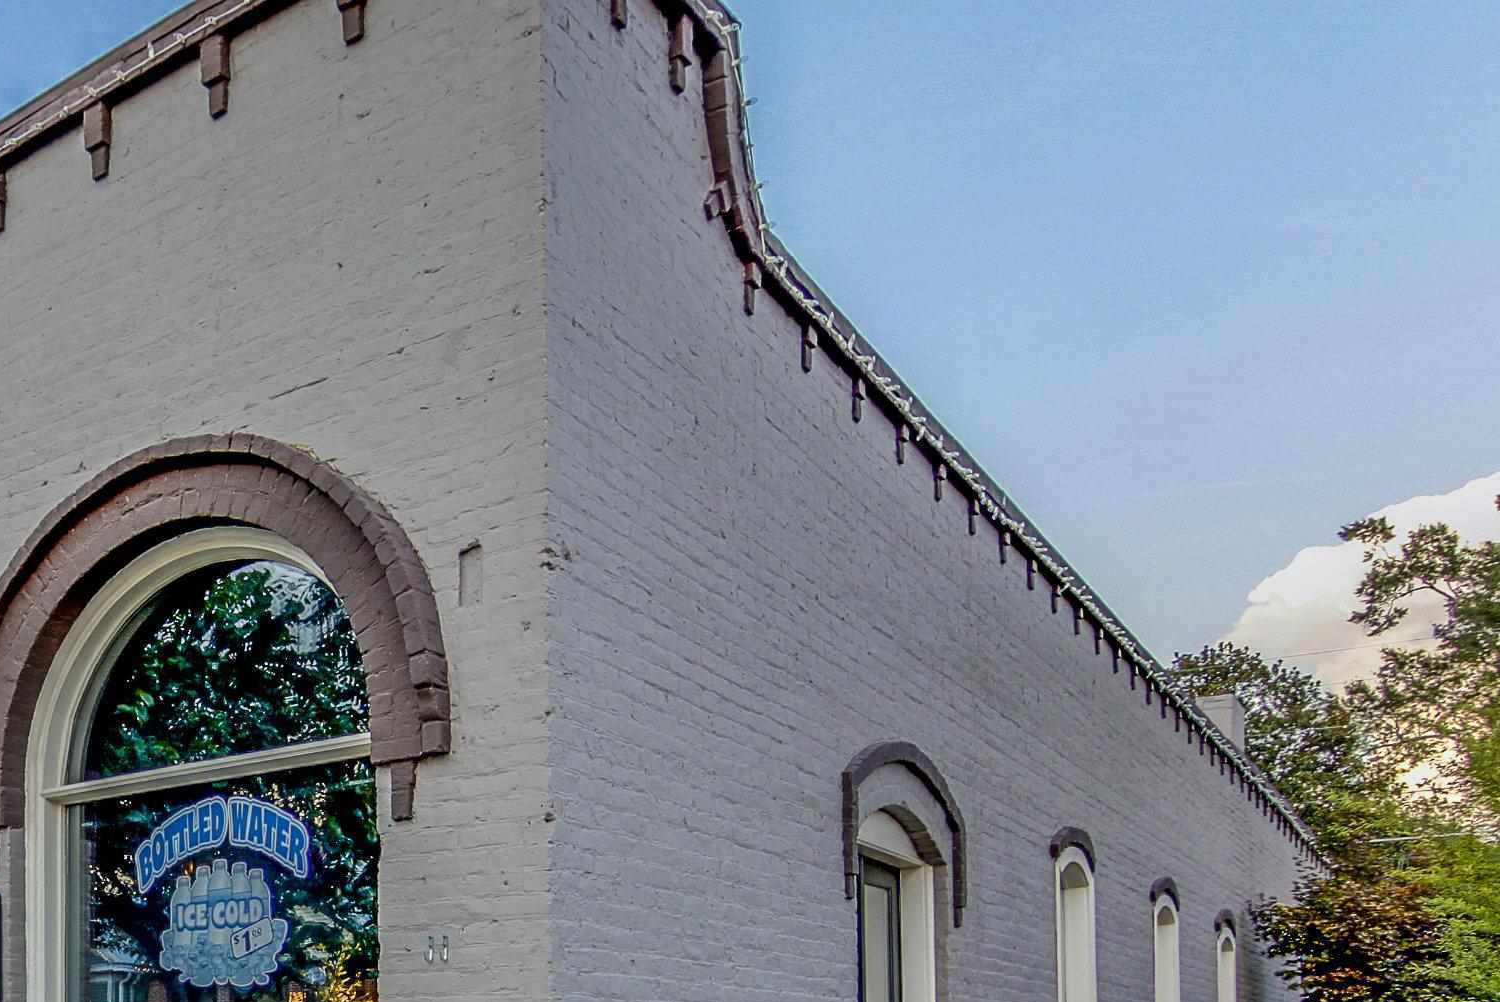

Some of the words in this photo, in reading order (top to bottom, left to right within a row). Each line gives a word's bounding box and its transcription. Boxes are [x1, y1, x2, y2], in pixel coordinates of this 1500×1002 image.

[137, 798, 227, 891] BOTTLED
[229, 797, 308, 877] WATER
[176, 901, 210, 931] ICE
[211, 898, 264, 928] COLD
